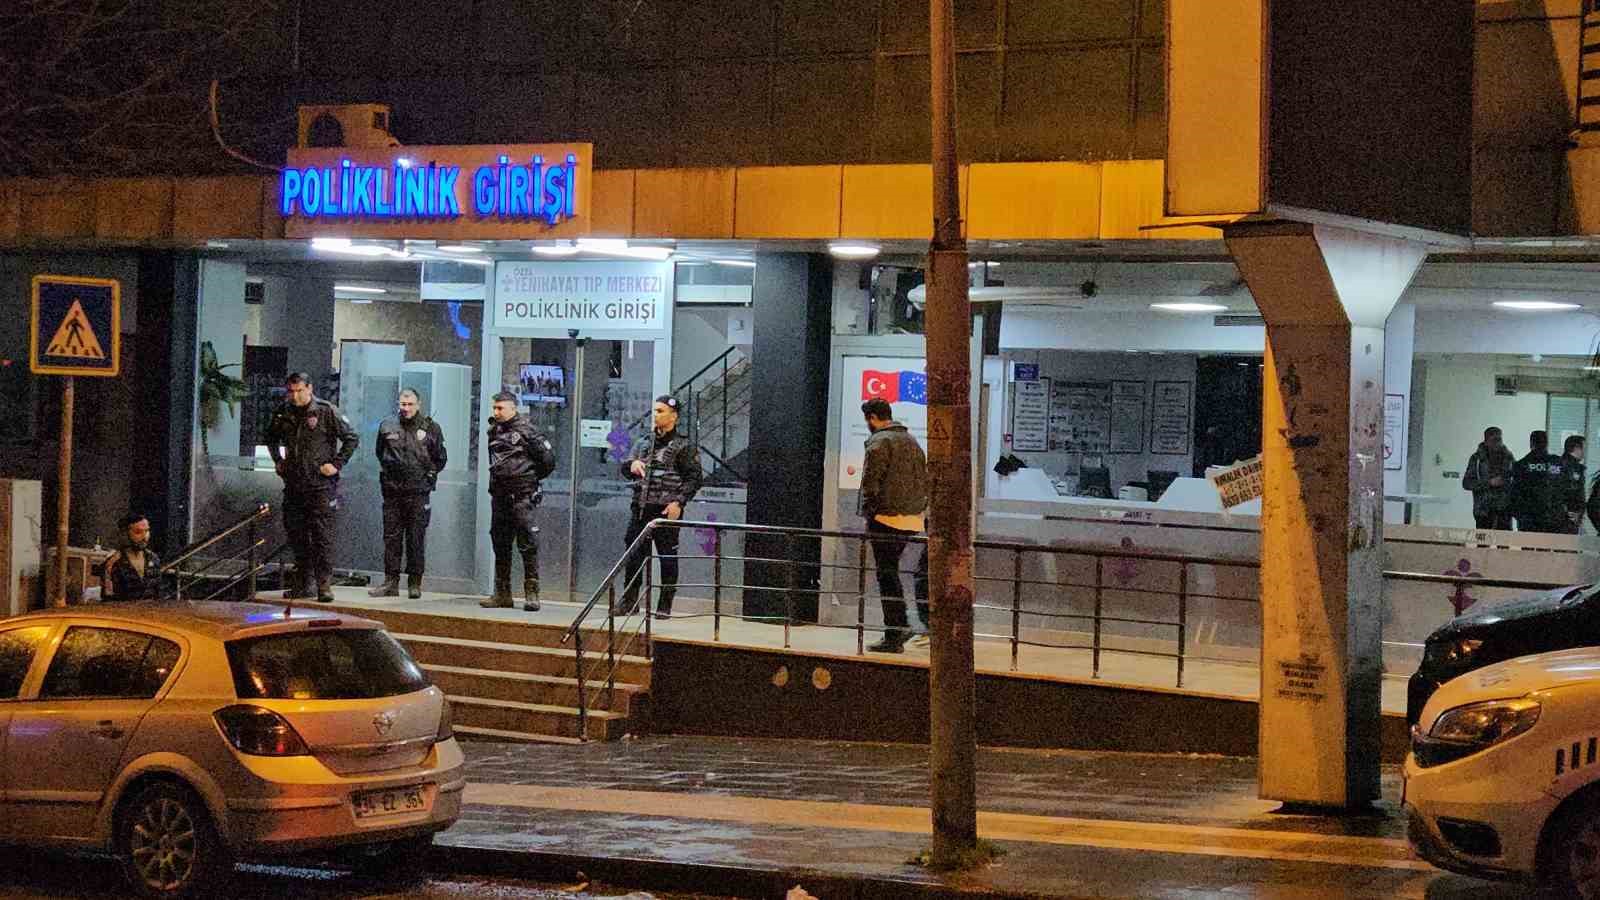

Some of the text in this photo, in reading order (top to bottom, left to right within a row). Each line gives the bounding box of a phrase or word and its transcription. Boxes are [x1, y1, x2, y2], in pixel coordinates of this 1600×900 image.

[282, 154, 576, 224] POLİKLİNİK GİRİŞİ
[585, 275, 602, 293] TIP
[505, 298, 656, 324] POLİKLİNİK GİRİŞİ
